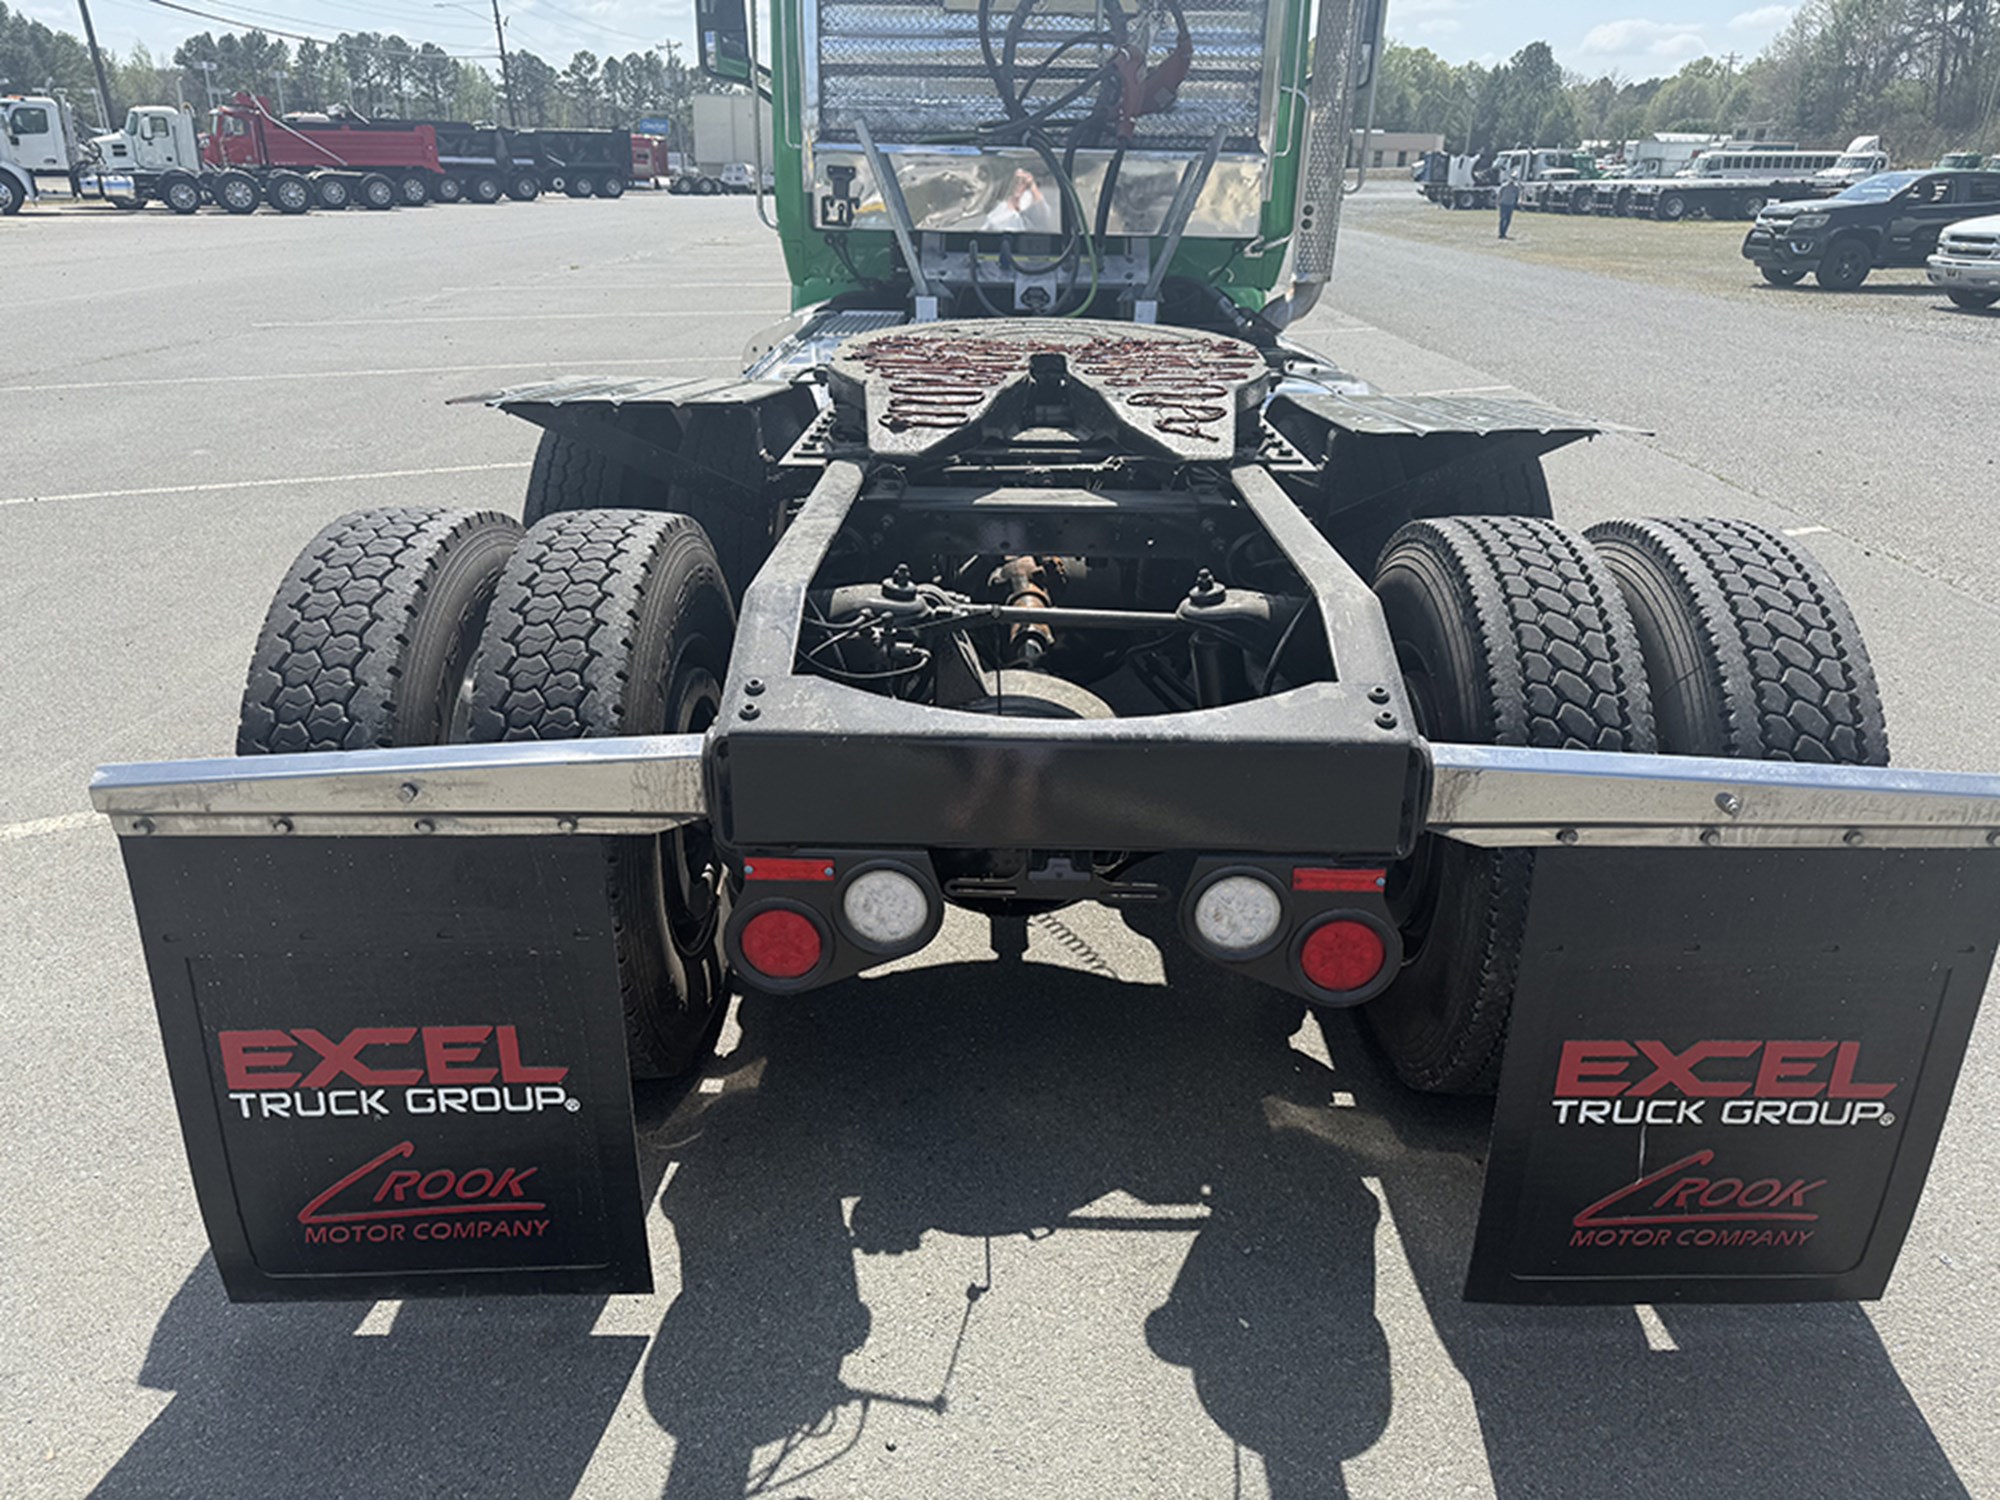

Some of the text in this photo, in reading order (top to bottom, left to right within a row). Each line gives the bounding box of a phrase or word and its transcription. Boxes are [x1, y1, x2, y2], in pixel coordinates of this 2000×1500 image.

[220, 1026, 569, 1088] EXCEL
[1554, 1040, 1897, 1098] EXCEL
[229, 1088, 390, 1118] TRUCK
[1552, 1100, 1706, 1125] TRUCK
[305, 1219, 551, 1244] MOTOR COMPANY
[1568, 1229, 1815, 1247] MOTOR COMPANY
